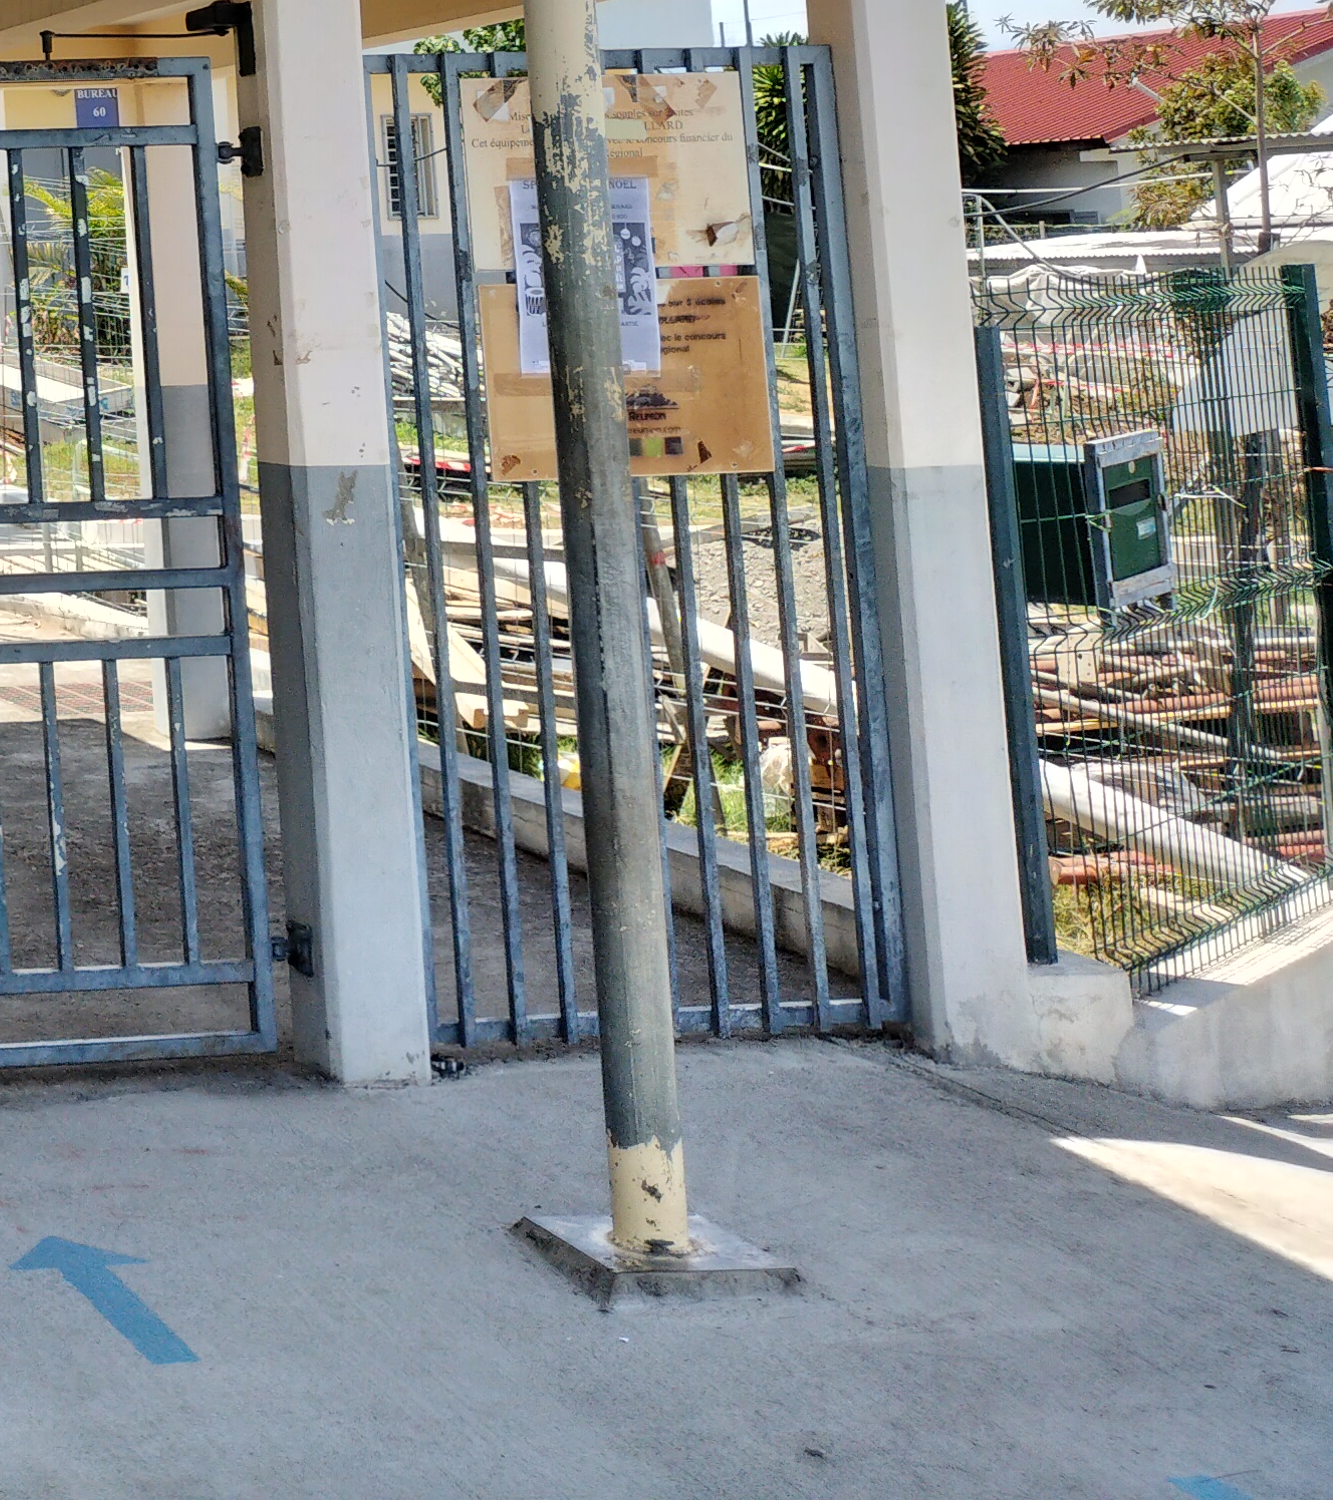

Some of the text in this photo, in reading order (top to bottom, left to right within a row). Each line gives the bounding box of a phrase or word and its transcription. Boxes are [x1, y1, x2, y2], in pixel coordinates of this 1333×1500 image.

[93, 107, 107, 117] 60
[644, 120, 683, 131] LLARD
[721, 132, 733, 141] du
[471, 138, 488, 148] Cet
